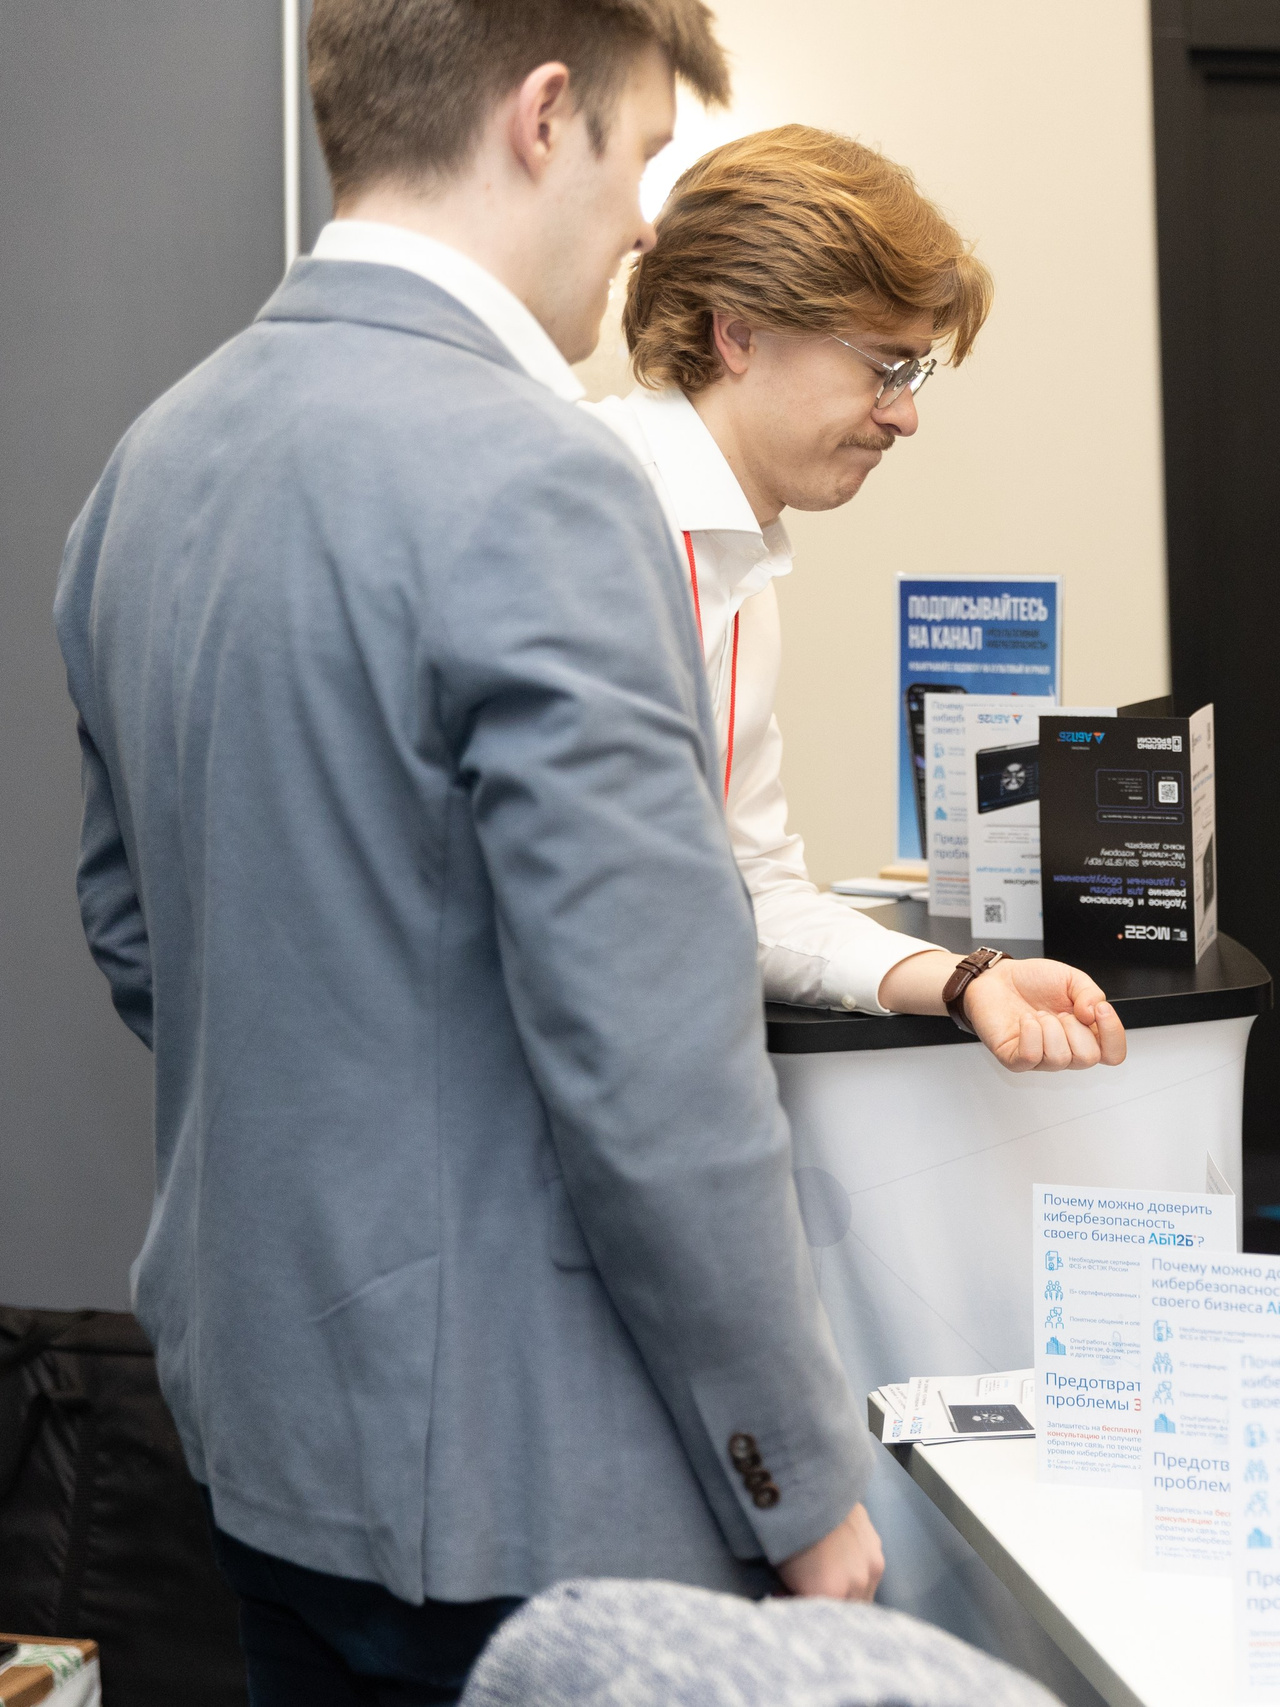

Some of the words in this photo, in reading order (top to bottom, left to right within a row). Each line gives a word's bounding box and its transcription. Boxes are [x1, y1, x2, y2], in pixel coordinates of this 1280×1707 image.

[908, 593, 1048, 621] ПОДПИСЫВАЙТЕСЬ
[908, 625, 930, 649] НА
[931, 626, 983, 650] КАНАЛ
[1058, 732, 1092, 742] АБП2Б
[1090, 887, 1122, 896] работы
[1148, 888, 1186, 897] решение
[1080, 896, 1134, 907] безопасное
[1148, 898, 1186, 909] Удобное
[1043, 1193, 1094, 1210] Почему
[1097, 1199, 1144, 1211] можно
[1147, 1201, 1213, 1216] доверить
[1043, 1211, 1175, 1230] кибербезопасность
[1043, 1229, 1088, 1241] своего
[1091, 1230, 1145, 1244] бизнеса
[1068, 1257, 1109, 1265] Необходимые
[1151, 1258, 1207, 1275] Почему
[1211, 1264, 1262, 1278] можно
[1151, 1296, 1200, 1310] своего
[1204, 1298, 1263, 1314] бизнеса
[1045, 1394, 1129, 1411] проблемы
[1047, 1420, 1090, 1431] Запишитесь
[1047, 1430, 1100, 1440] консультацию
[1047, 1439, 1083, 1448] обратную
[1153, 1452, 1230, 1472] Предотв
